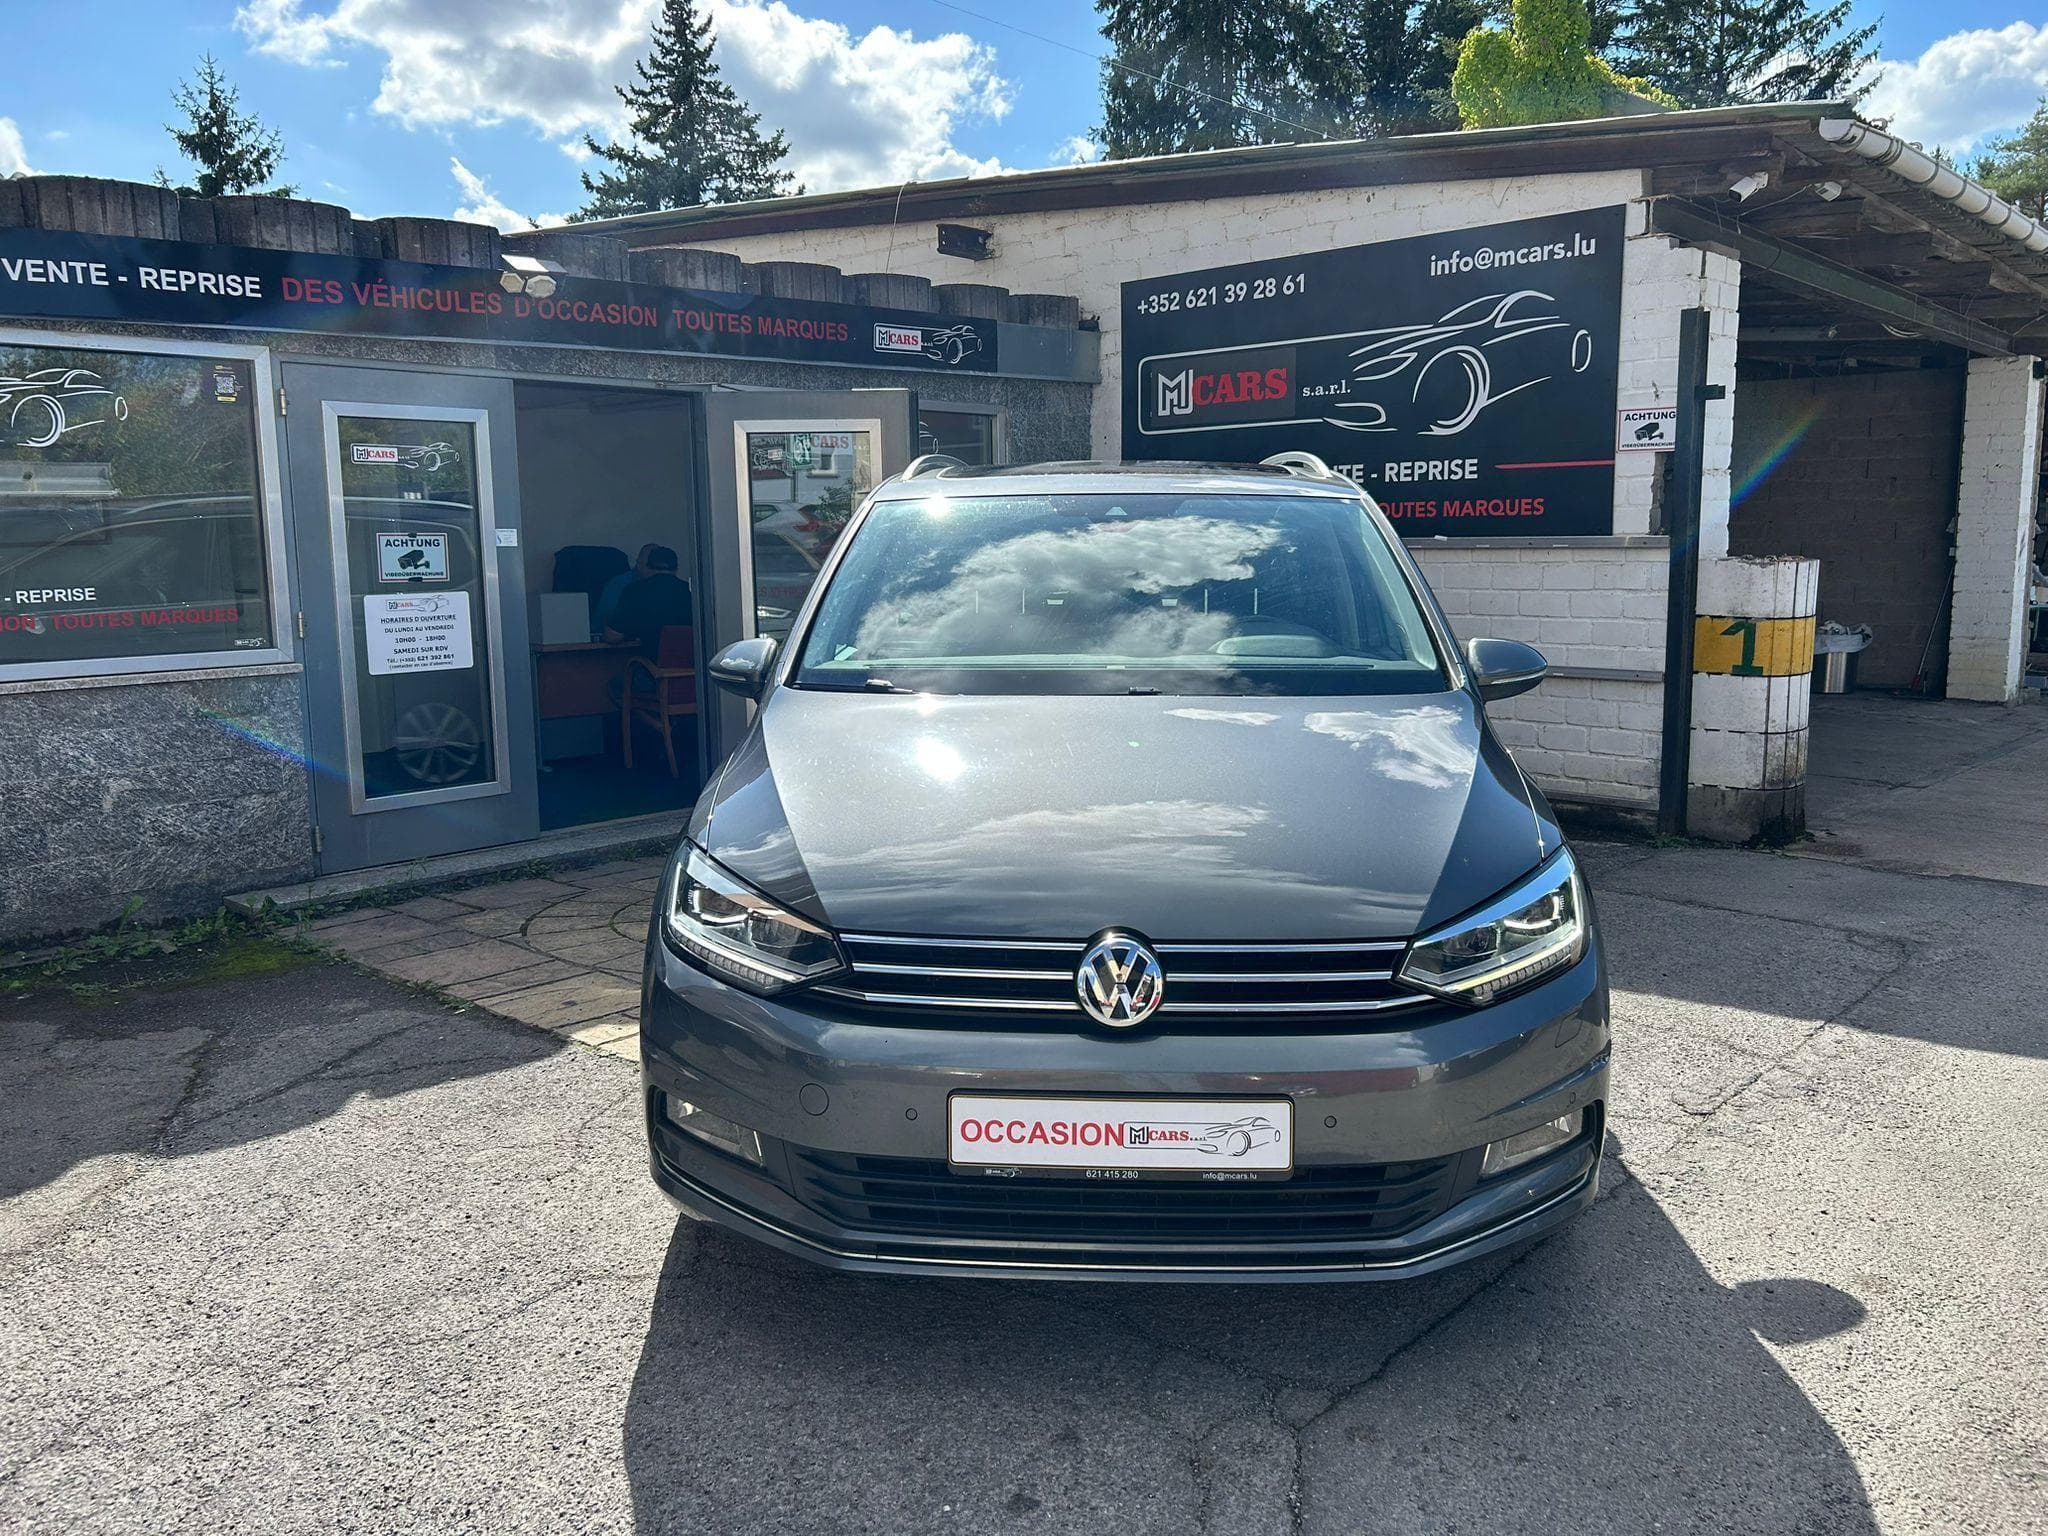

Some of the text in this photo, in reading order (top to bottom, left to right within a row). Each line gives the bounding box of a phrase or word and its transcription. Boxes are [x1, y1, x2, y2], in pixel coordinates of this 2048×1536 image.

[1430, 232, 1597, 277] info@mcars.lu
[1, 257, 110, 286] VENTE
[138, 266, 262, 298] REPRISE
[282, 277, 344, 305] DES
[351, 279, 502, 316] VÉHICULES
[672, 309, 753, 334] TOUTES
[757, 316, 849, 342] MARQUES
[1137, 273, 1305, 315] +352 621 39 28 61
[1302, 379, 1351, 397] s.a.r.l.
[1624, 411, 1676, 422] ACHTUNG
[1384, 459, 1479, 483] REPRISE
[1443, 498, 1544, 517] MARQUES
[385, 539, 440, 547] ACHTUNG
[15, 587, 97, 604] REPRISE
[53, 611, 136, 631] TOUTES
[140, 607, 240, 625] MARQUES
[1720, 620, 1764, 676] 1
[960, 1119, 1124, 1147] OCCASION
[1086, 1170, 1101, 1178] 621
[1122, 1171, 1139, 1179] 280
[1203, 1172, 1257, 1181] info@mcars.lu
